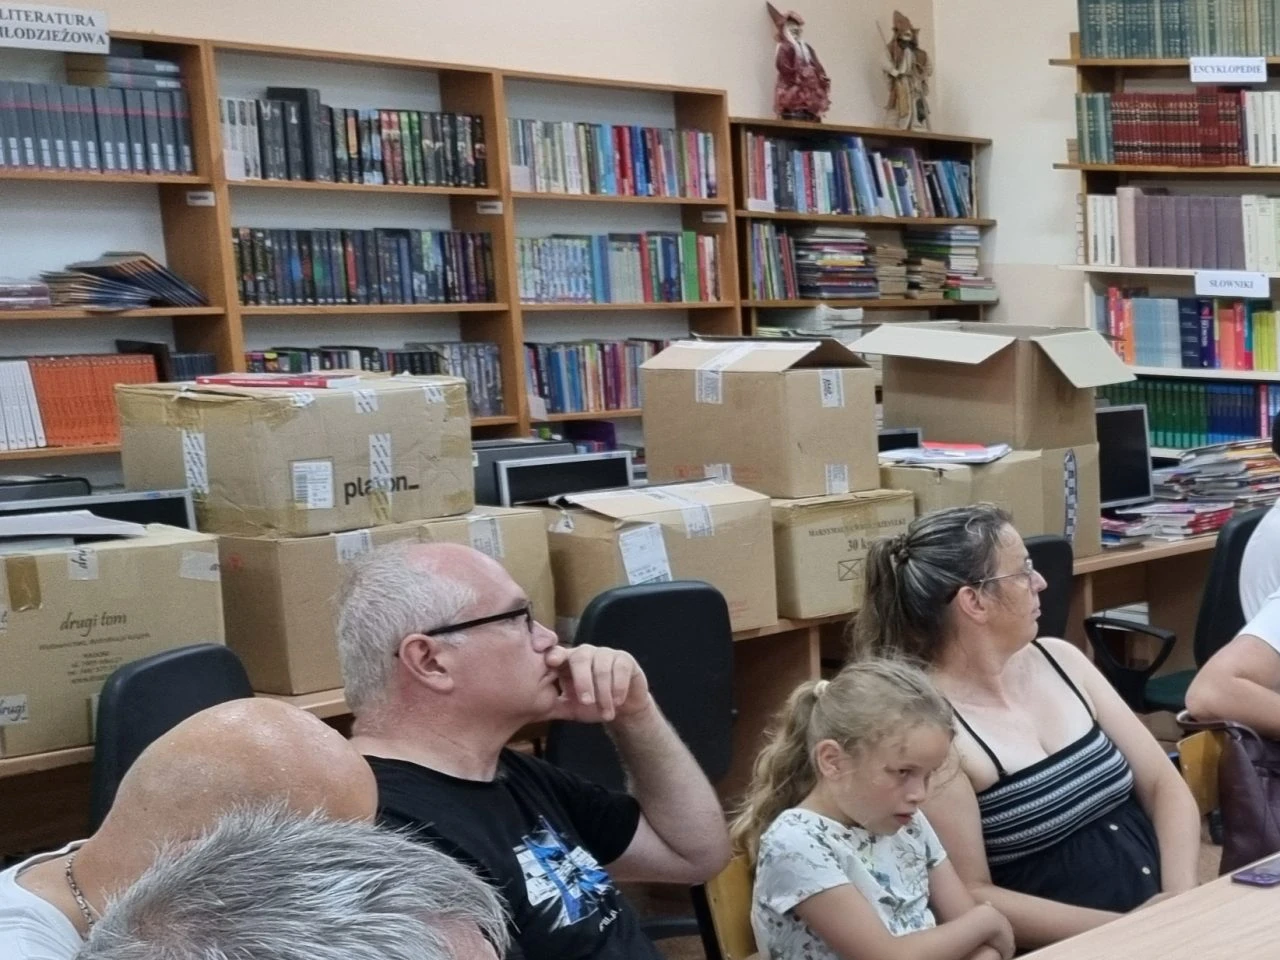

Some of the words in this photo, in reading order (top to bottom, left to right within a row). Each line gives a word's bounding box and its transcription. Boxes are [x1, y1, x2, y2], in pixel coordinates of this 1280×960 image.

[0, 8, 95, 27] LITERATURA
[1193, 64, 1263, 74] ENCYKLOPEDIE
[1208, 279, 1254, 289] SŁOWNIKI
[344, 475, 420, 505] plaon_
[848, 540, 858, 552] 30
[60, 612, 98, 637] drugi
[101, 611, 127, 627] tom
